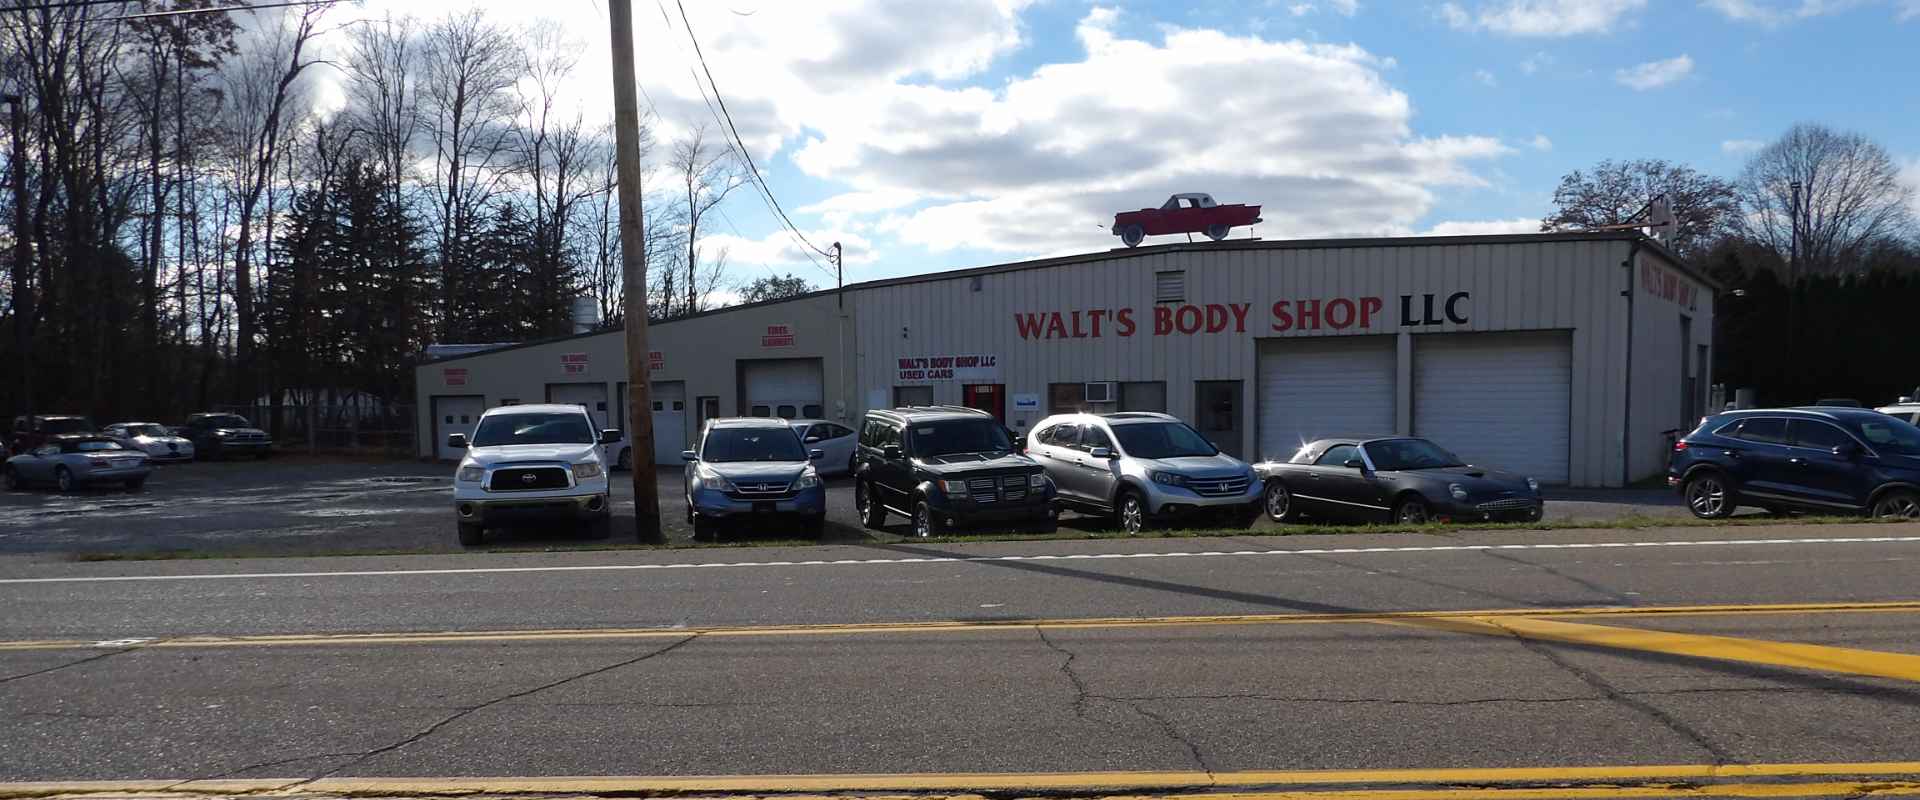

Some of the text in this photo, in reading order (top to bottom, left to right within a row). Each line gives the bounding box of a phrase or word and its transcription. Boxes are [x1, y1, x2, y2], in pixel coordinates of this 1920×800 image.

[1015, 292, 1470, 340] WALT'S BODY SHOP LLC
[767, 326, 787, 335] TIRES
[762, 338, 794, 346] ALIGNMENTS
[650, 351, 662, 359] KES
[898, 356, 995, 369] WALT'S BODY SHOP LLC
[899, 370, 953, 379] USED CARS
